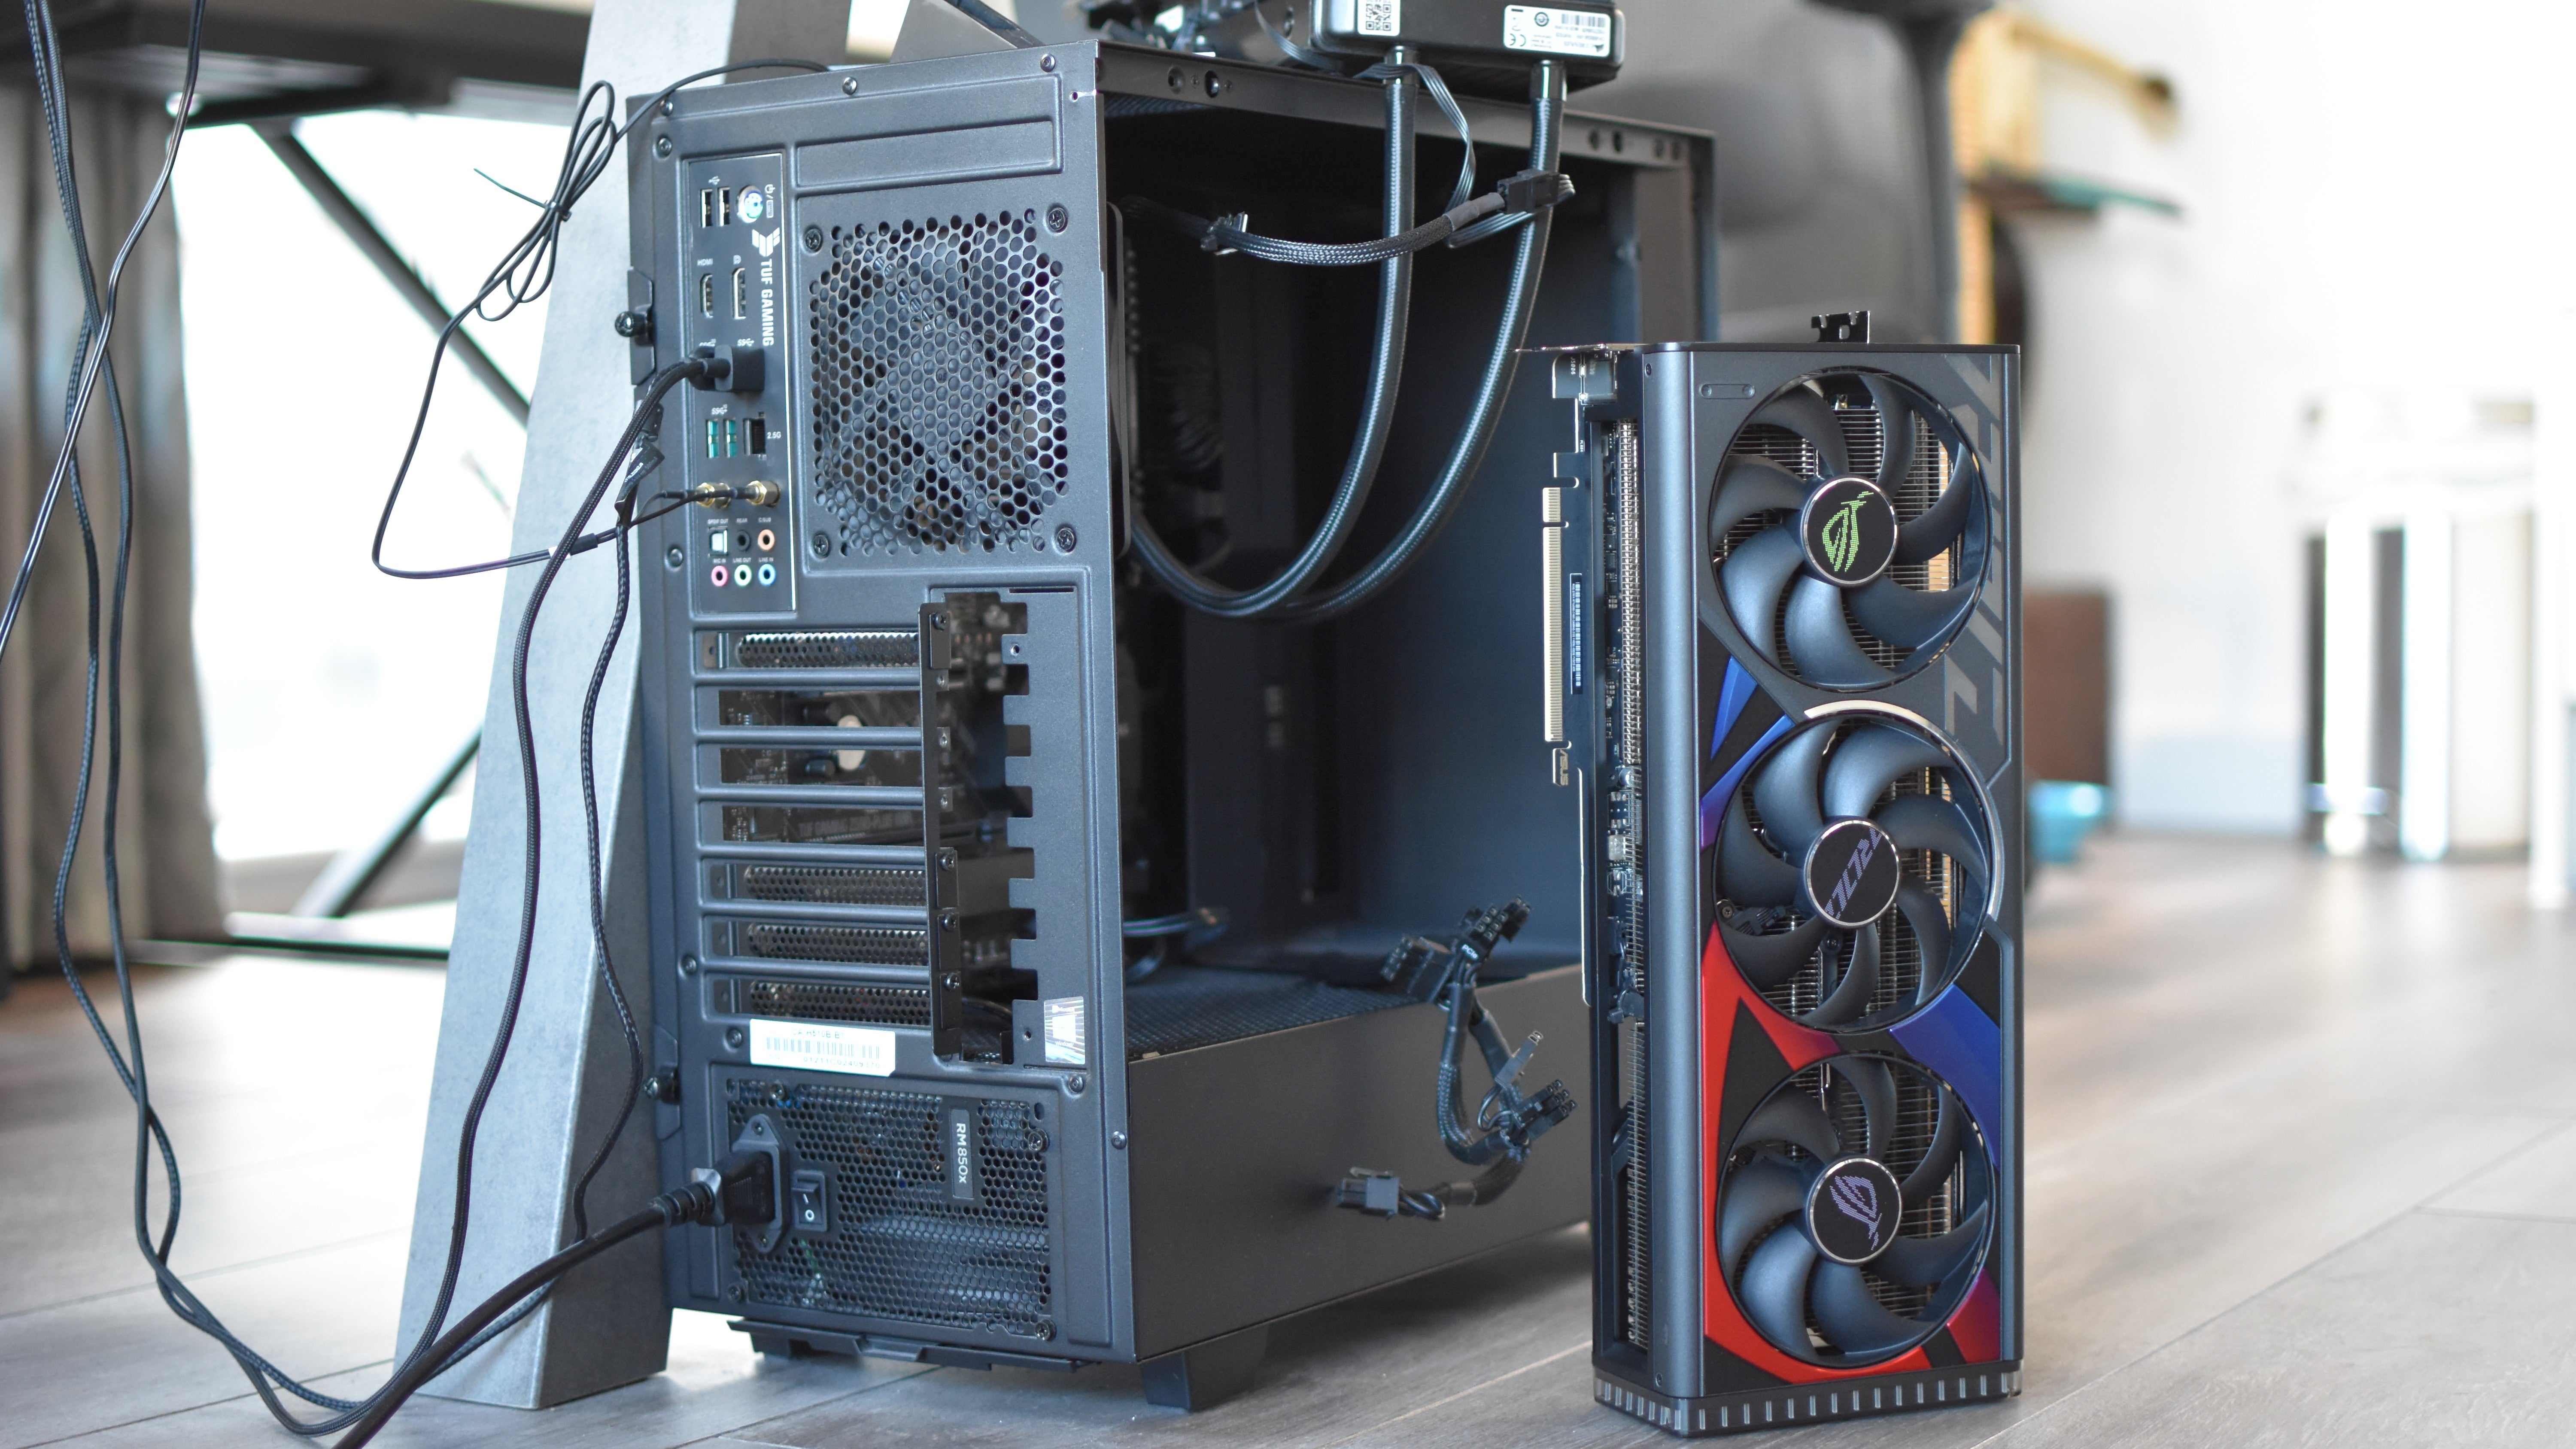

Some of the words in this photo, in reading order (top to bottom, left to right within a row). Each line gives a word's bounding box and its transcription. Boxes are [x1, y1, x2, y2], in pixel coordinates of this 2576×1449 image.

[760, 258, 772, 285] TUF
[761, 289, 774, 346] GAMING
[767, 431, 781, 439] 2.5G
[1560, 749, 1568, 785] ASUS
[1462, 944, 1478, 959] PCIe
[956, 1123, 968, 1183] RM850x
